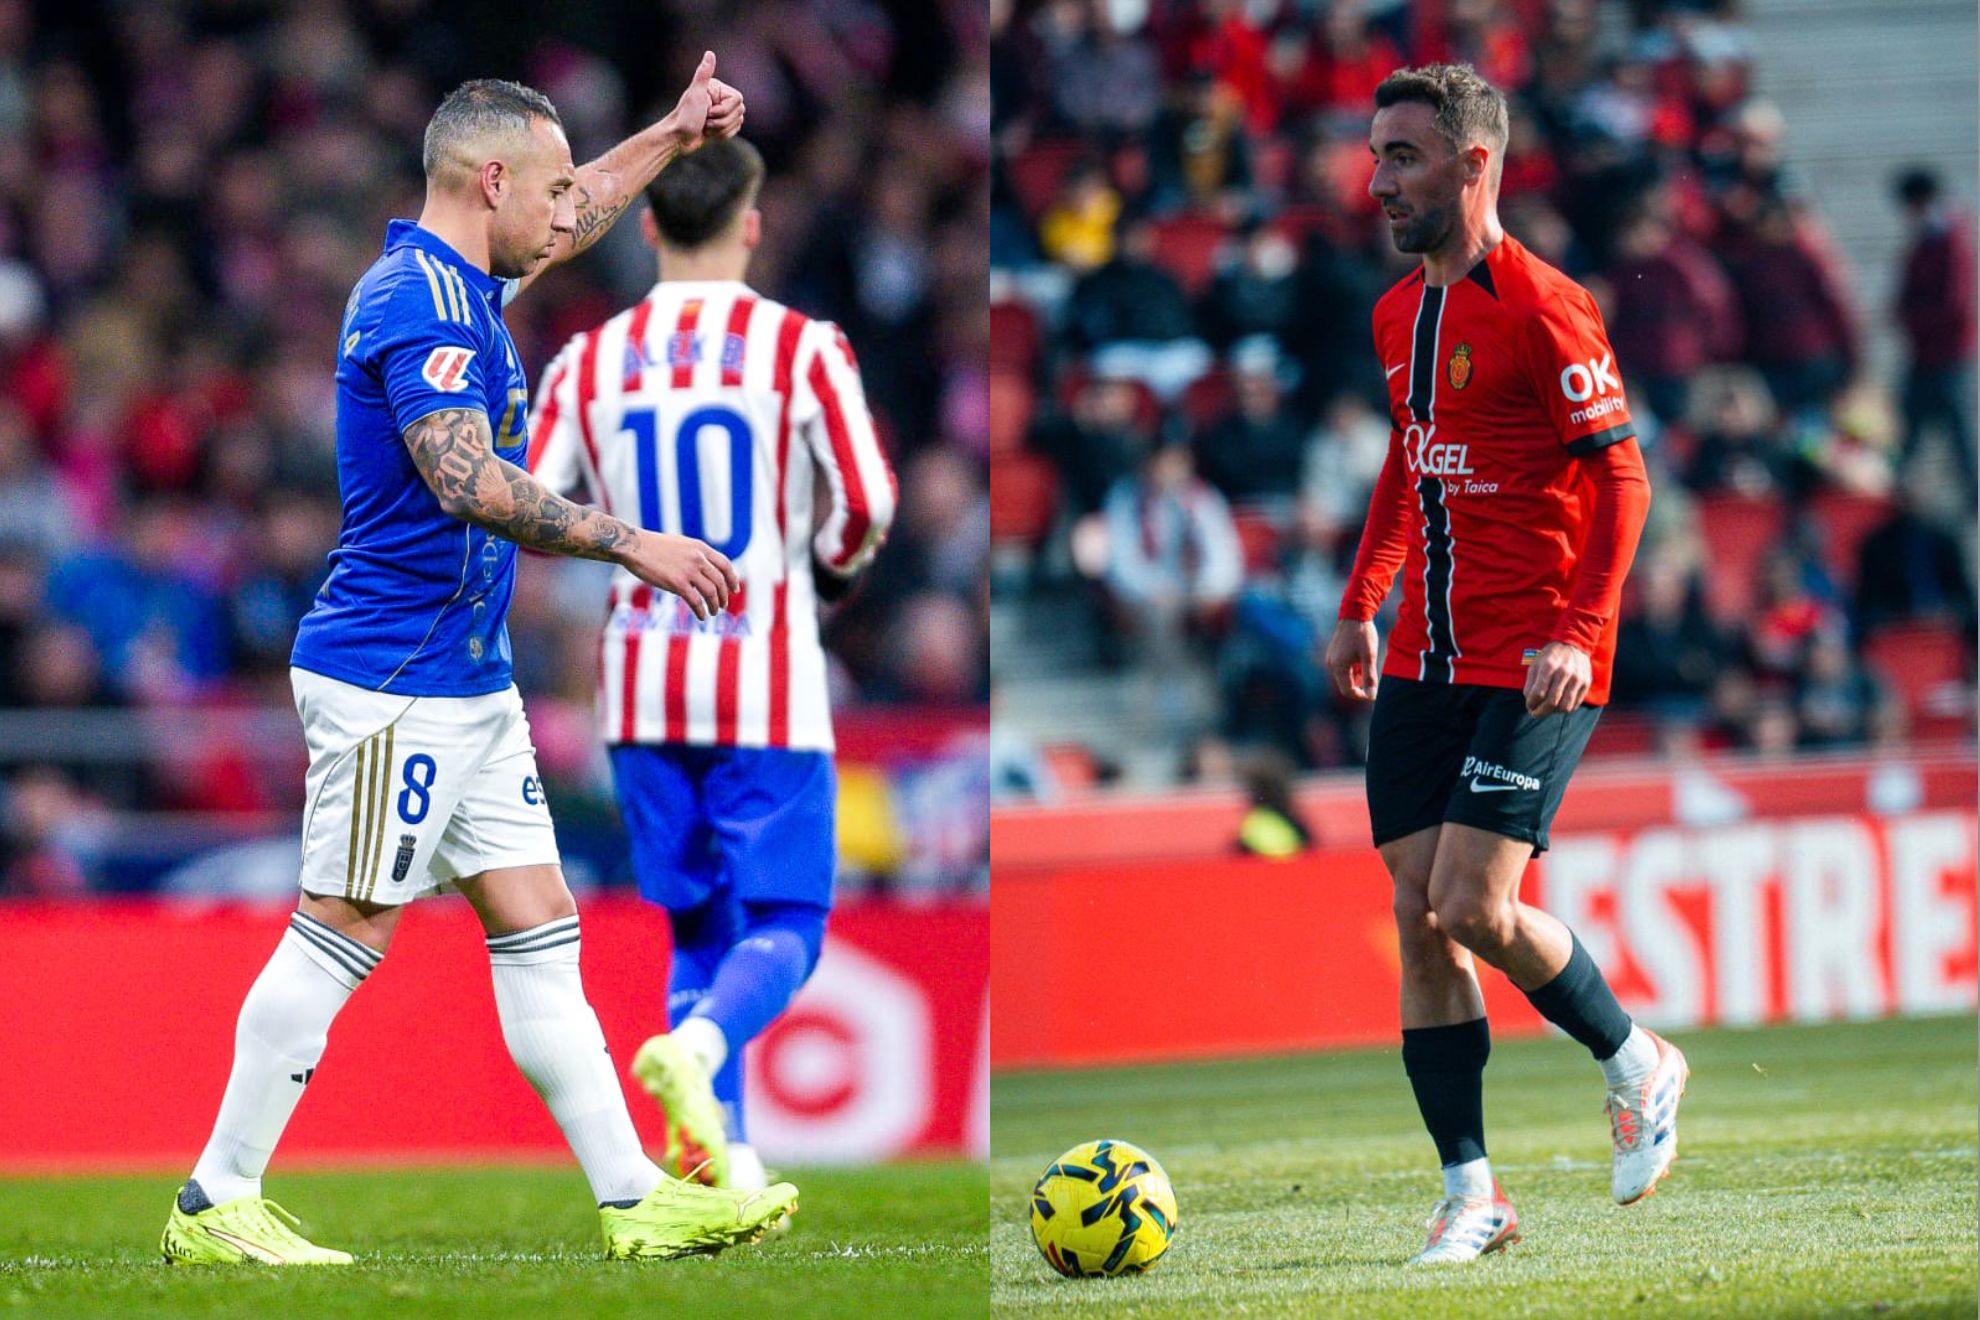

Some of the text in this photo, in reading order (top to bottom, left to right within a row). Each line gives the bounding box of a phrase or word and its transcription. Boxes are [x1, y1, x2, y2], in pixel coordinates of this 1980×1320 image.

[1560, 351, 1619, 402] OK
[1570, 396, 1625, 424] mobility
[619, 406, 753, 561] 10
[1447, 480, 1499, 496] by Taica
[397, 753, 437, 825] 8
